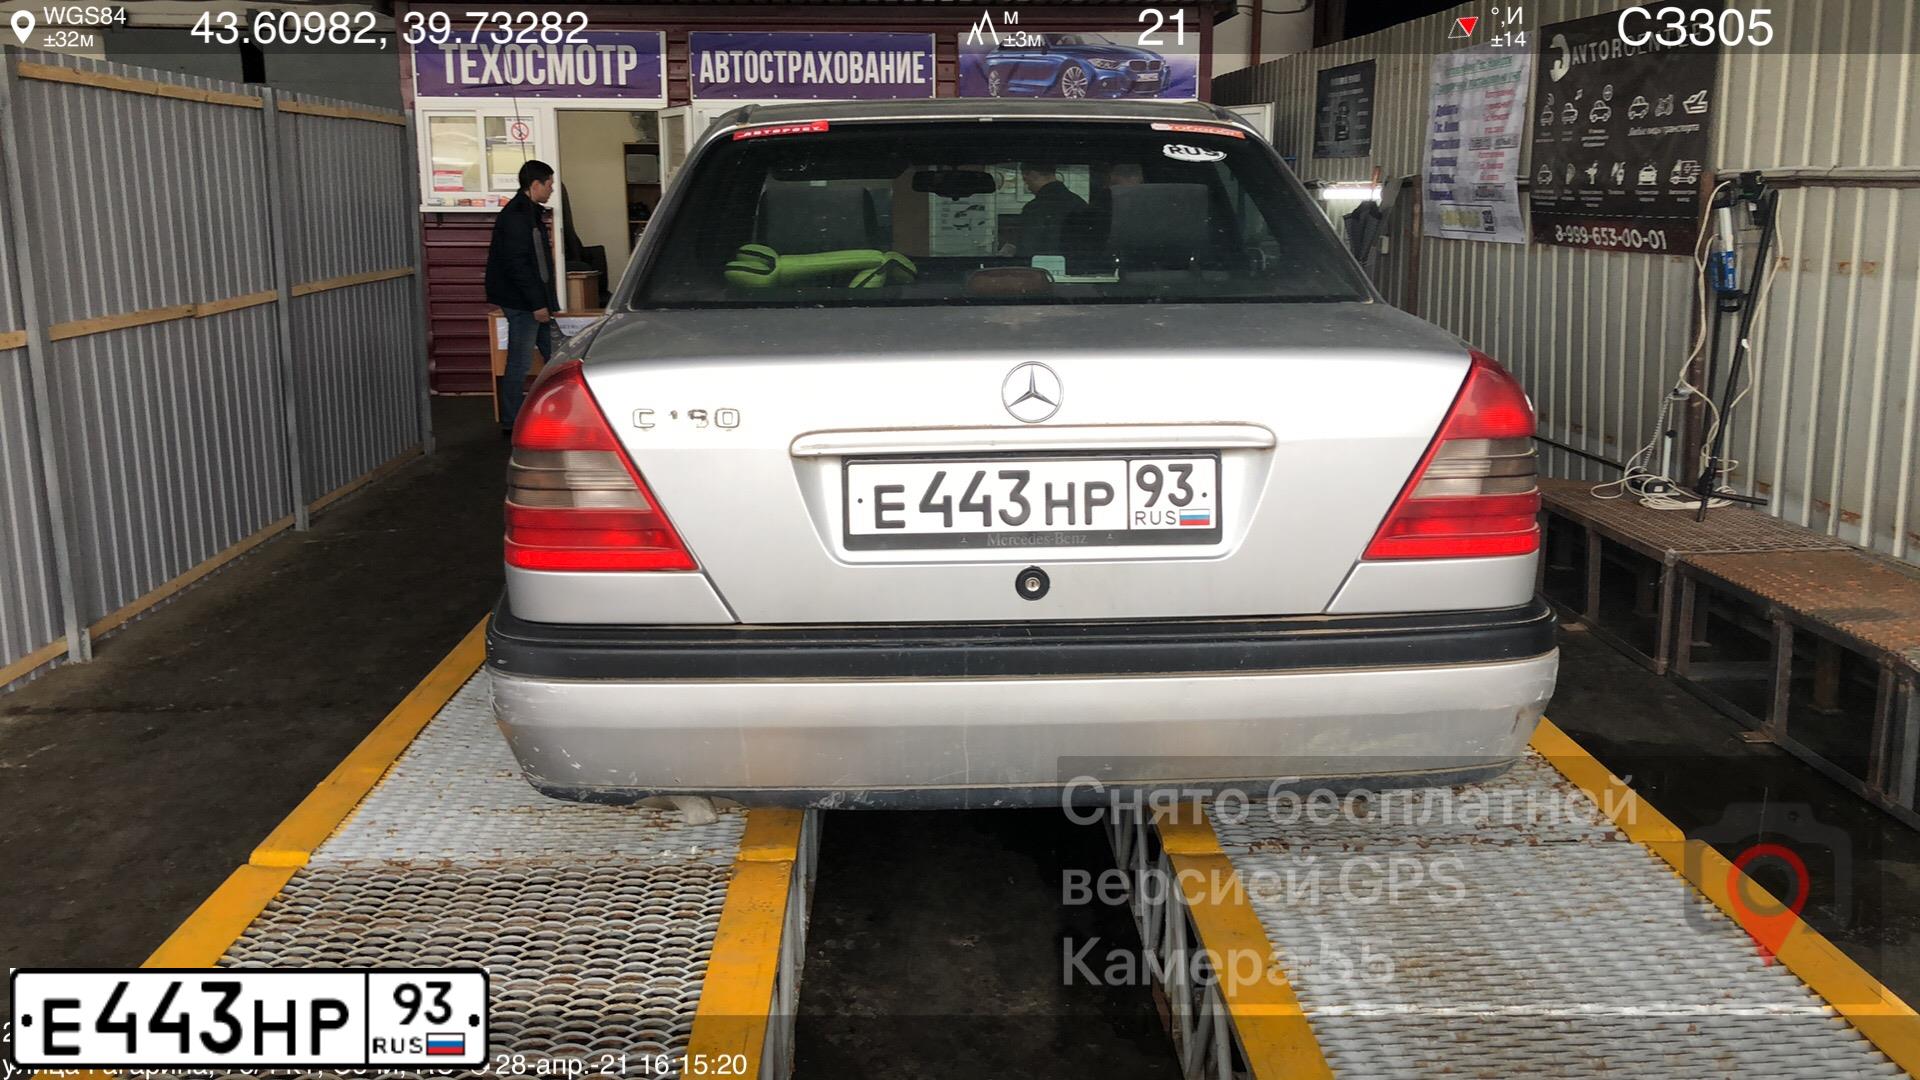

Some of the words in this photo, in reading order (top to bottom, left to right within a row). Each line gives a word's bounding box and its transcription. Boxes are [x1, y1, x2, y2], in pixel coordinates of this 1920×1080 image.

[438, 43, 638, 86] ТЕХОСМОТР
[700, 50, 926, 84] АВТОСТРАХОВАНИЕ
[1555, 224, 1667, 250] 8-999-653-00-01
[1136, 463, 1194, 508] 93
[1135, 510, 1177, 526] RUS
[987, 532, 1089, 547] Mercedes-Benz
